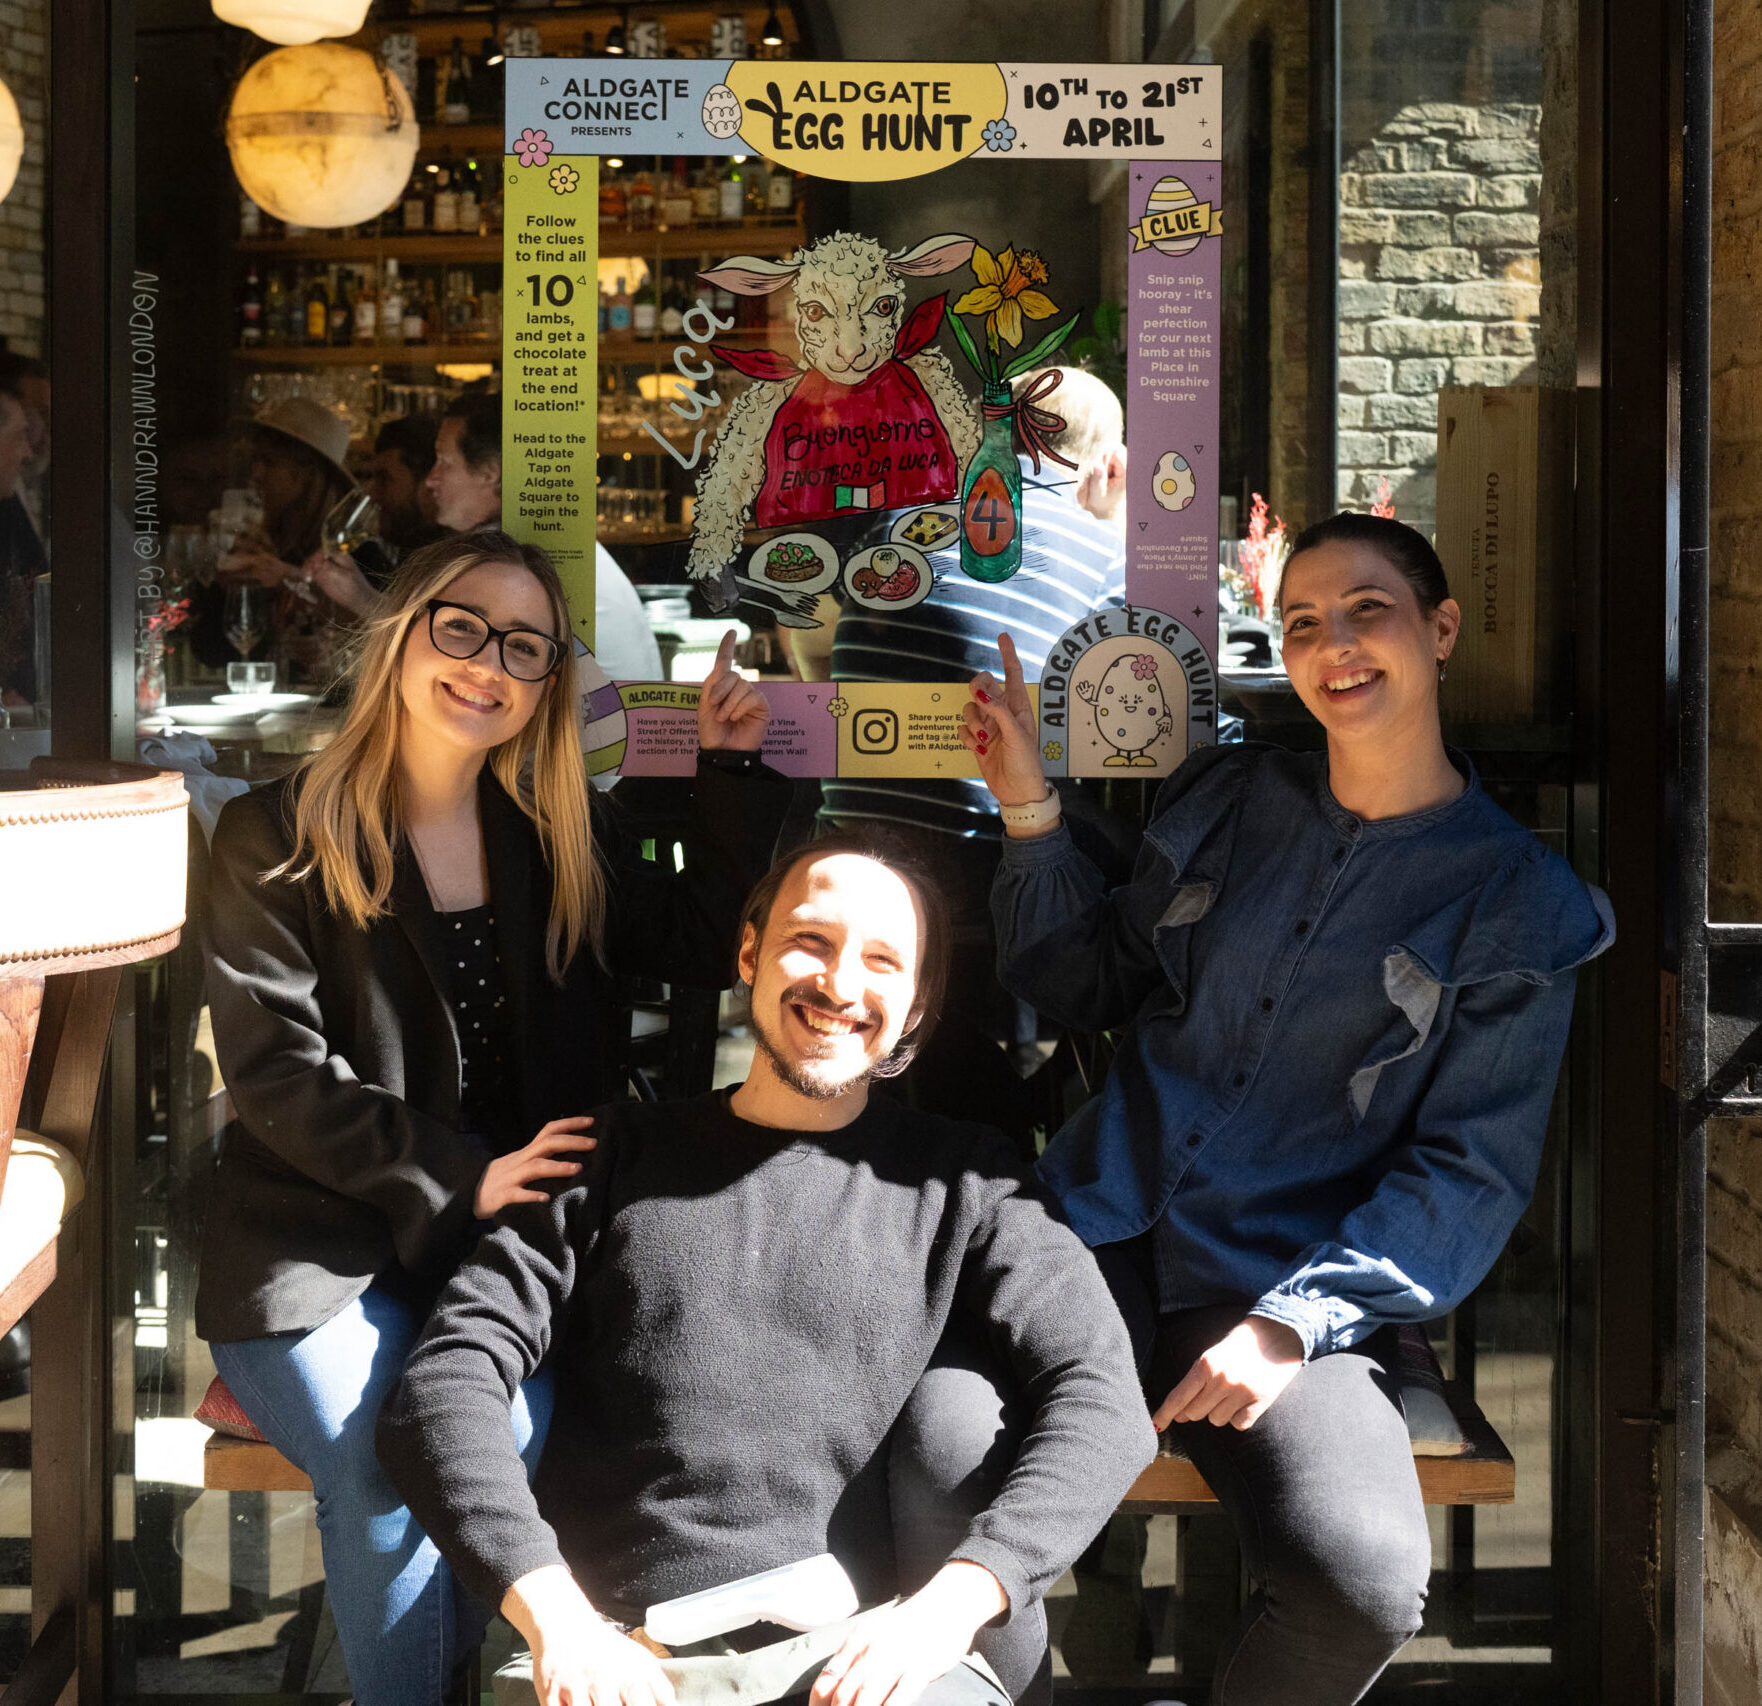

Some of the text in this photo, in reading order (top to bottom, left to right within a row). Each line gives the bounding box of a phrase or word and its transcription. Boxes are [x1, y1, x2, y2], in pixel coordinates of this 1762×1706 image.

[562, 78, 689, 98] ALDGATE
[793, 80, 951, 104] ALDGATE
[1024, 77, 1203, 110] 10TH TO 21ST
[544, 101, 667, 121] CONNECT
[571, 126, 632, 136] PRESENTS
[772, 112, 972, 152] EGG HUNT
[1063, 117, 1165, 147] APRIL
[526, 215, 576, 228] Follow
[1150, 210, 1202, 237] CLUE
[518, 233, 584, 245] the clues
[516, 250, 586, 262] to find all
[1147, 274, 1204, 286] Snip snip
[526, 274, 574, 307] 10
[1138, 289, 1182, 300] hooray
[1158, 304, 1192, 314] shear
[526, 312, 574, 326] lambs,
[1143, 318, 1208, 330] perfection
[515, 330, 585, 344] and get a
[1138, 332, 1212, 344] for our next
[514, 347, 587, 360] chocolate
[1138, 348, 1212, 358] lamb at this
[522, 365, 578, 377] treat at
[1151, 362, 1199, 373] Place in
[522, 382, 578, 394] the end
[641, 298, 735, 470] Luca
[1140, 376, 1210, 388] Devonshire
[1153, 390, 1197, 402] Square
[513, 434, 586, 444] Head to the
[783, 418, 935, 461] Buongiorno
[524, 448, 574, 460] Aldgate
[528, 463, 571, 474] Tap on
[780, 452, 940, 490] ENOTECA DA LUCA
[524, 477, 574, 489] Aldgate
[519, 492, 580, 504] Square to
[520, 506, 578, 518] begin the
[971, 492, 1007, 541] 4
[533, 521, 564, 532] hunt.
[1471, 528, 1480, 578] TENUTA
[1484, 472, 1499, 634] BOCCA DI LUPO
[137, 566, 165, 599] BY
[1043, 606, 1214, 728] ALDGATE EGG HUNT
[628, 690, 677, 704] ALDGATE
[636, 718, 658, 726] Have
[777, 718, 796, 726] Vine
[768, 728, 806, 736] London's
